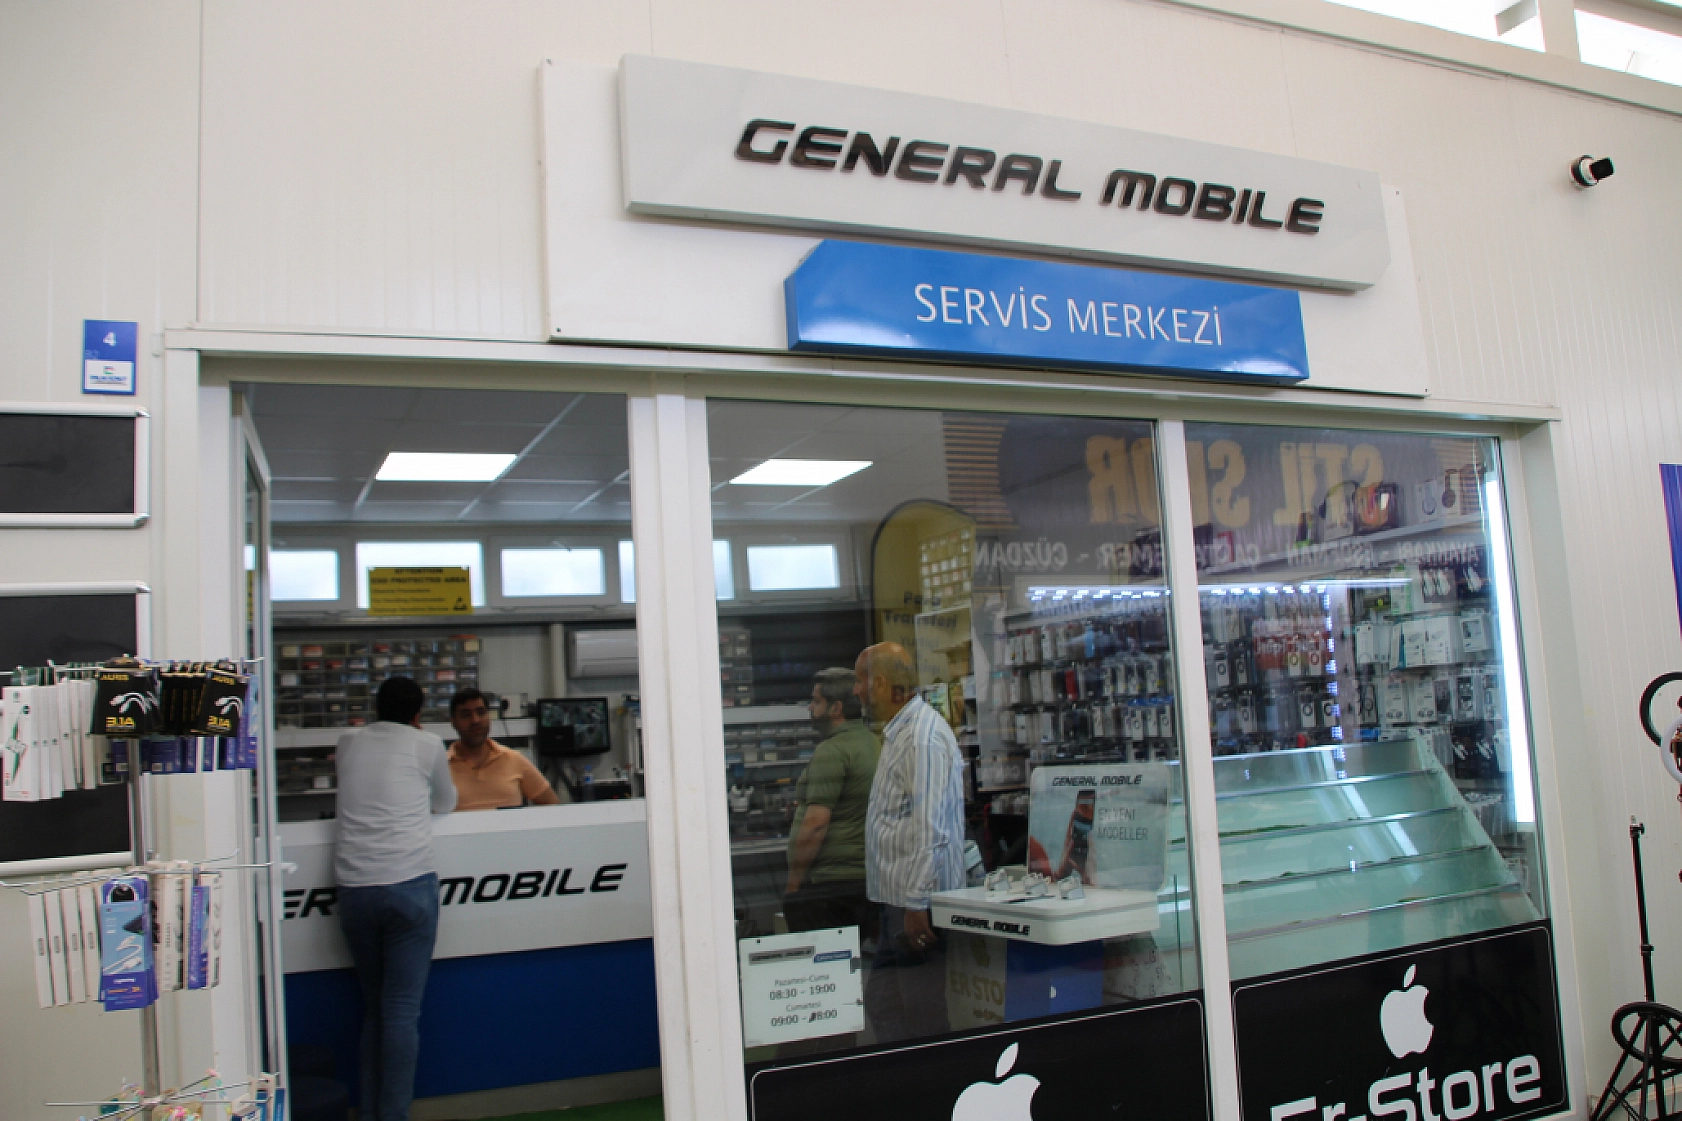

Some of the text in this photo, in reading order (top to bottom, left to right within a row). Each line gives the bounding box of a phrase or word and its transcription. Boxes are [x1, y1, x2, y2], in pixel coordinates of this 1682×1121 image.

[733, 117, 1326, 235] GENERAL MOBILE
[914, 283, 1223, 346] SERVİS MERKEZİ
[102, 331, 117, 347] 4
[1052, 774, 1143, 787] GENERAL MOBILE
[438, 863, 628, 906] MOBILE
[951, 914, 1031, 937] GENERAL MOBILE
[769, 988, 796, 1000] 08:30
[808, 983, 836, 996] 19:00
[771, 1015, 799, 1026] 09:00
